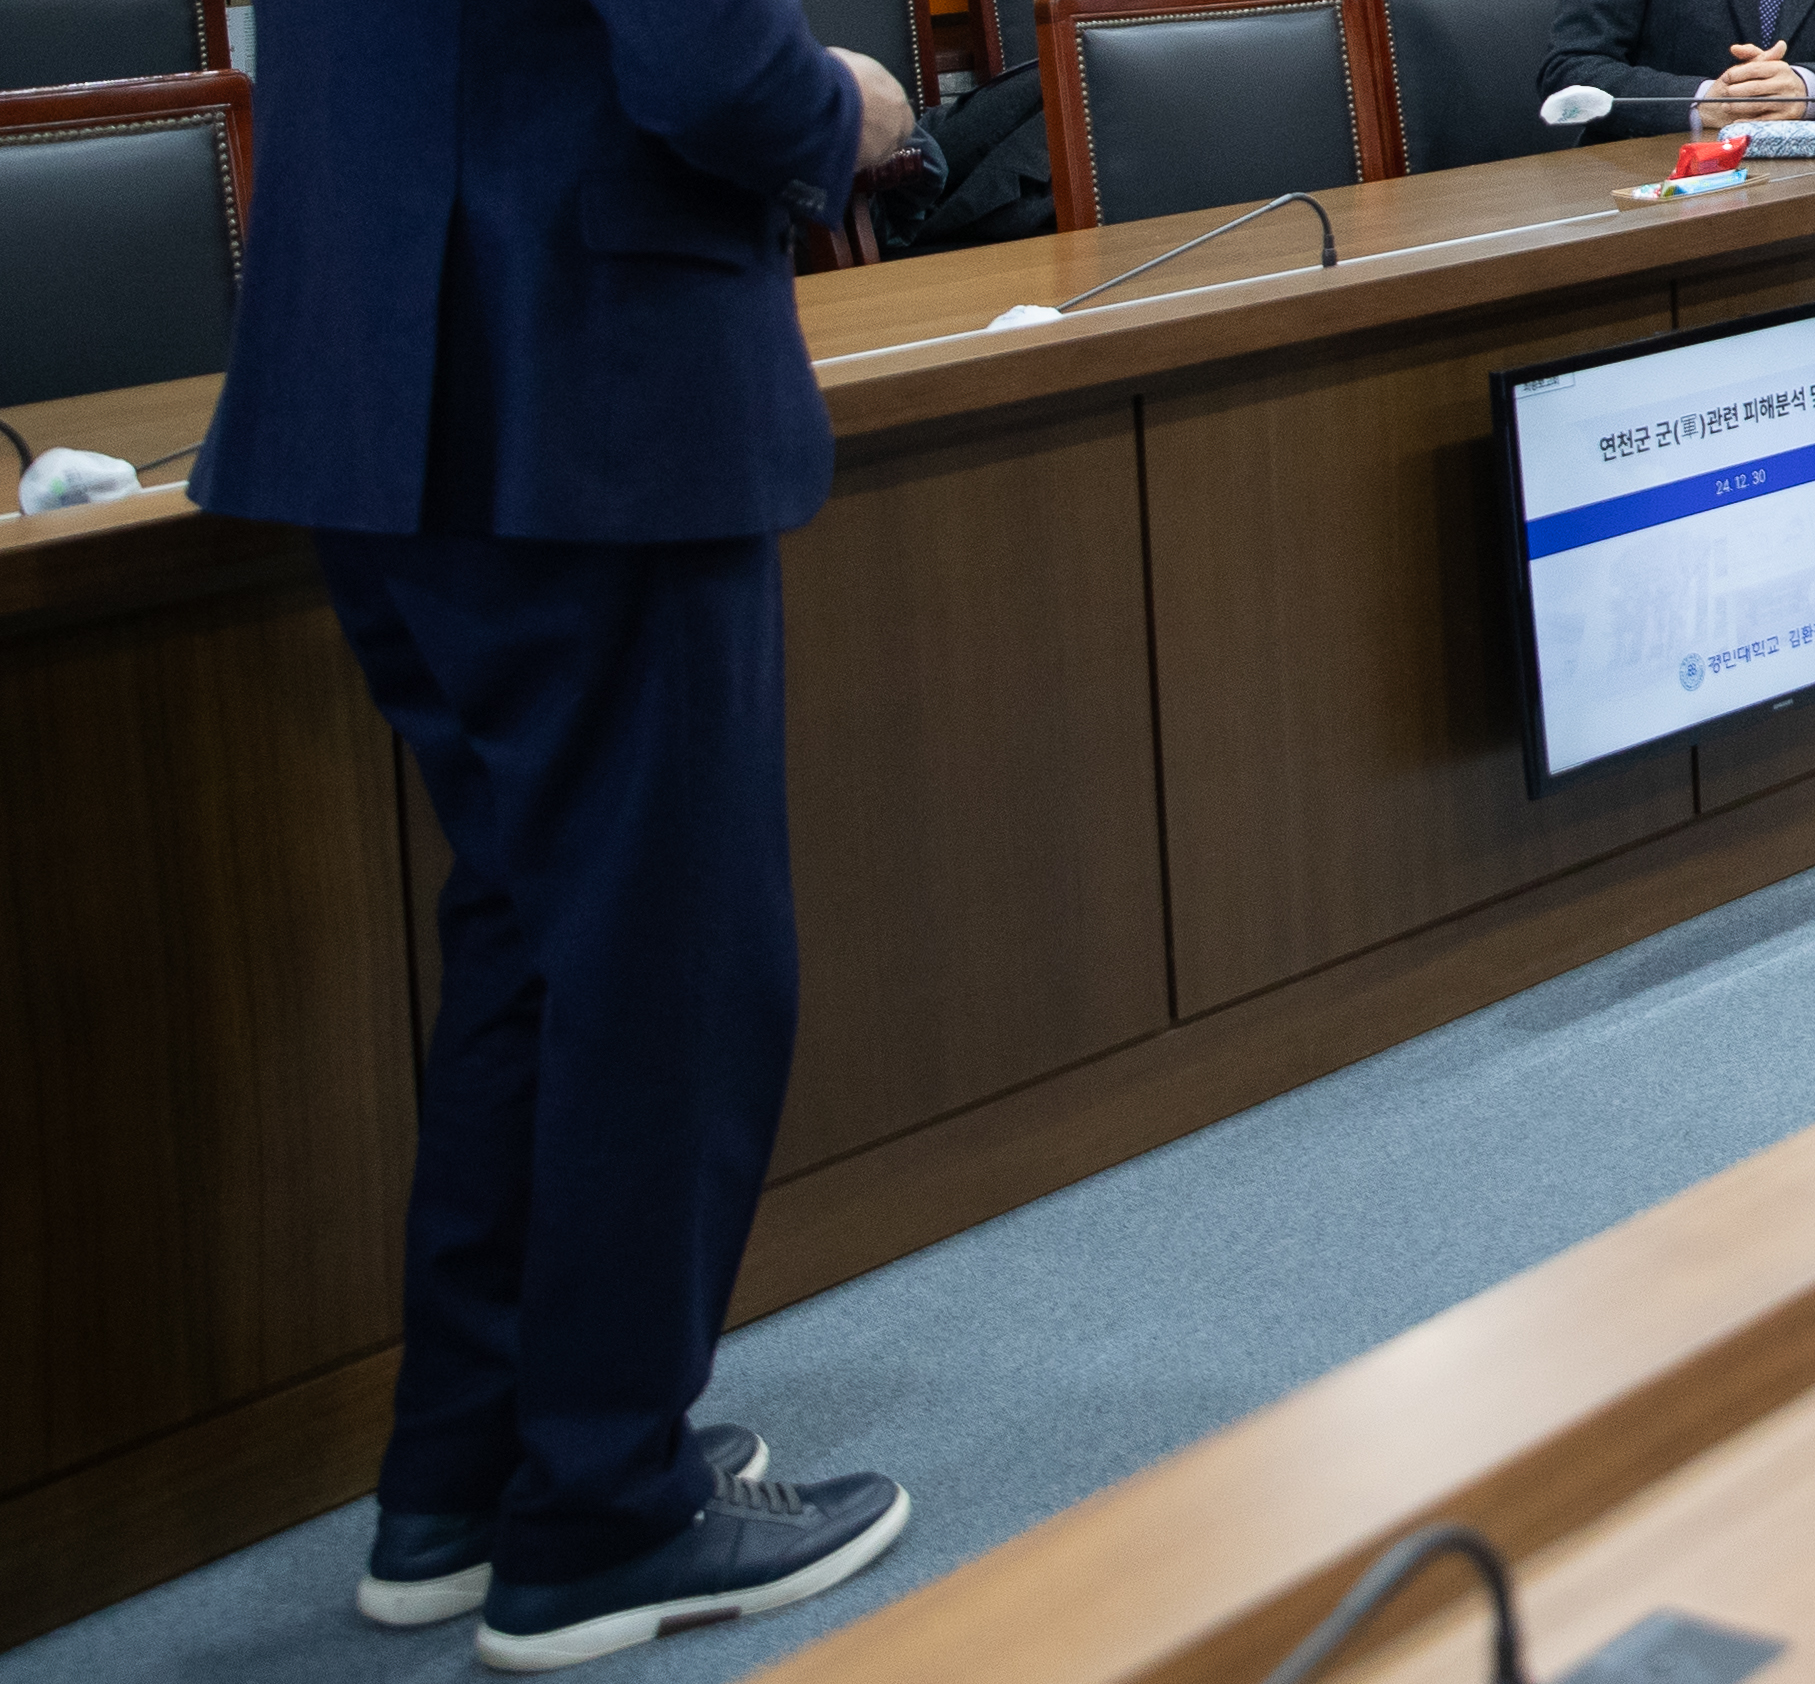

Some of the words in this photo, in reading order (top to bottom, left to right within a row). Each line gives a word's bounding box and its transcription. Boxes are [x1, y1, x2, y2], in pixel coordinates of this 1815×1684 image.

[1599, 424, 1651, 462] 연천군
[1655, 402, 1739, 448] 군(軍)관련
[1743, 387, 1806, 424] 피해분석
